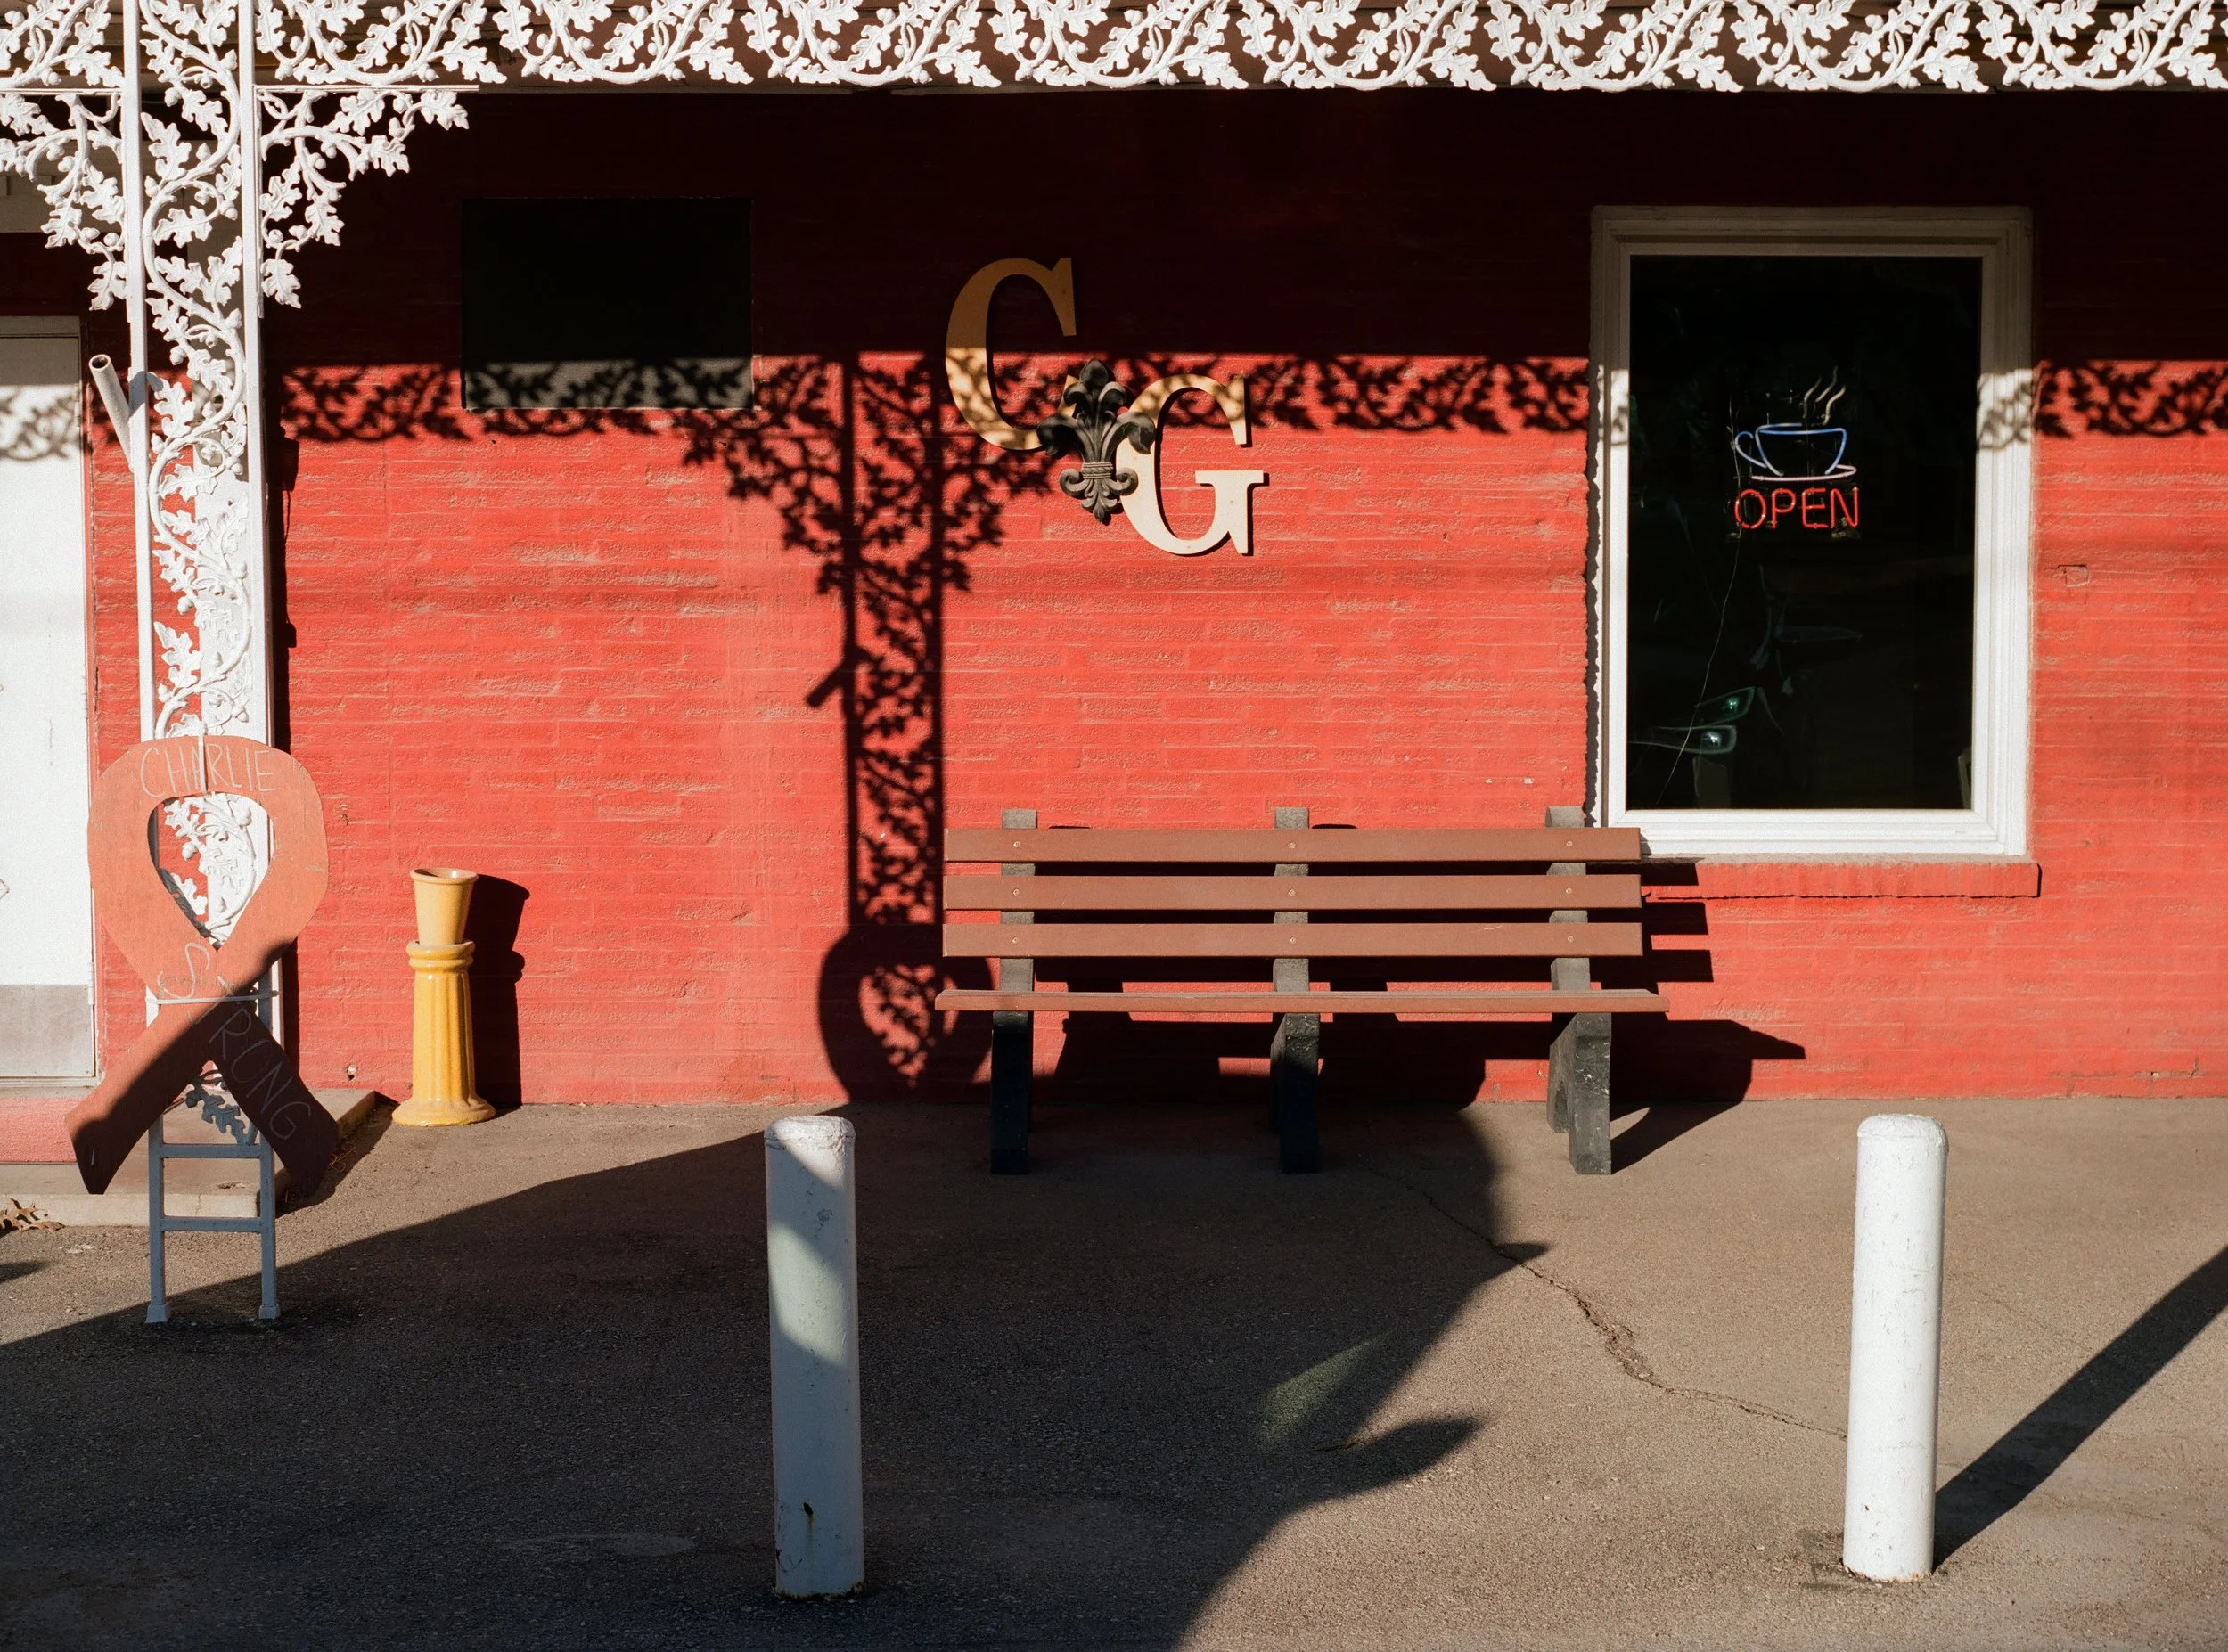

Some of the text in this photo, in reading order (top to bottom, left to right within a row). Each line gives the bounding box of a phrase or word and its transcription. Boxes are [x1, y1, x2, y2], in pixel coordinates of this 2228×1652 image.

[945, 257, 1265, 555] C G
[1735, 487, 1859, 529] OPEN
[140, 743, 277, 797] CHARLIE
